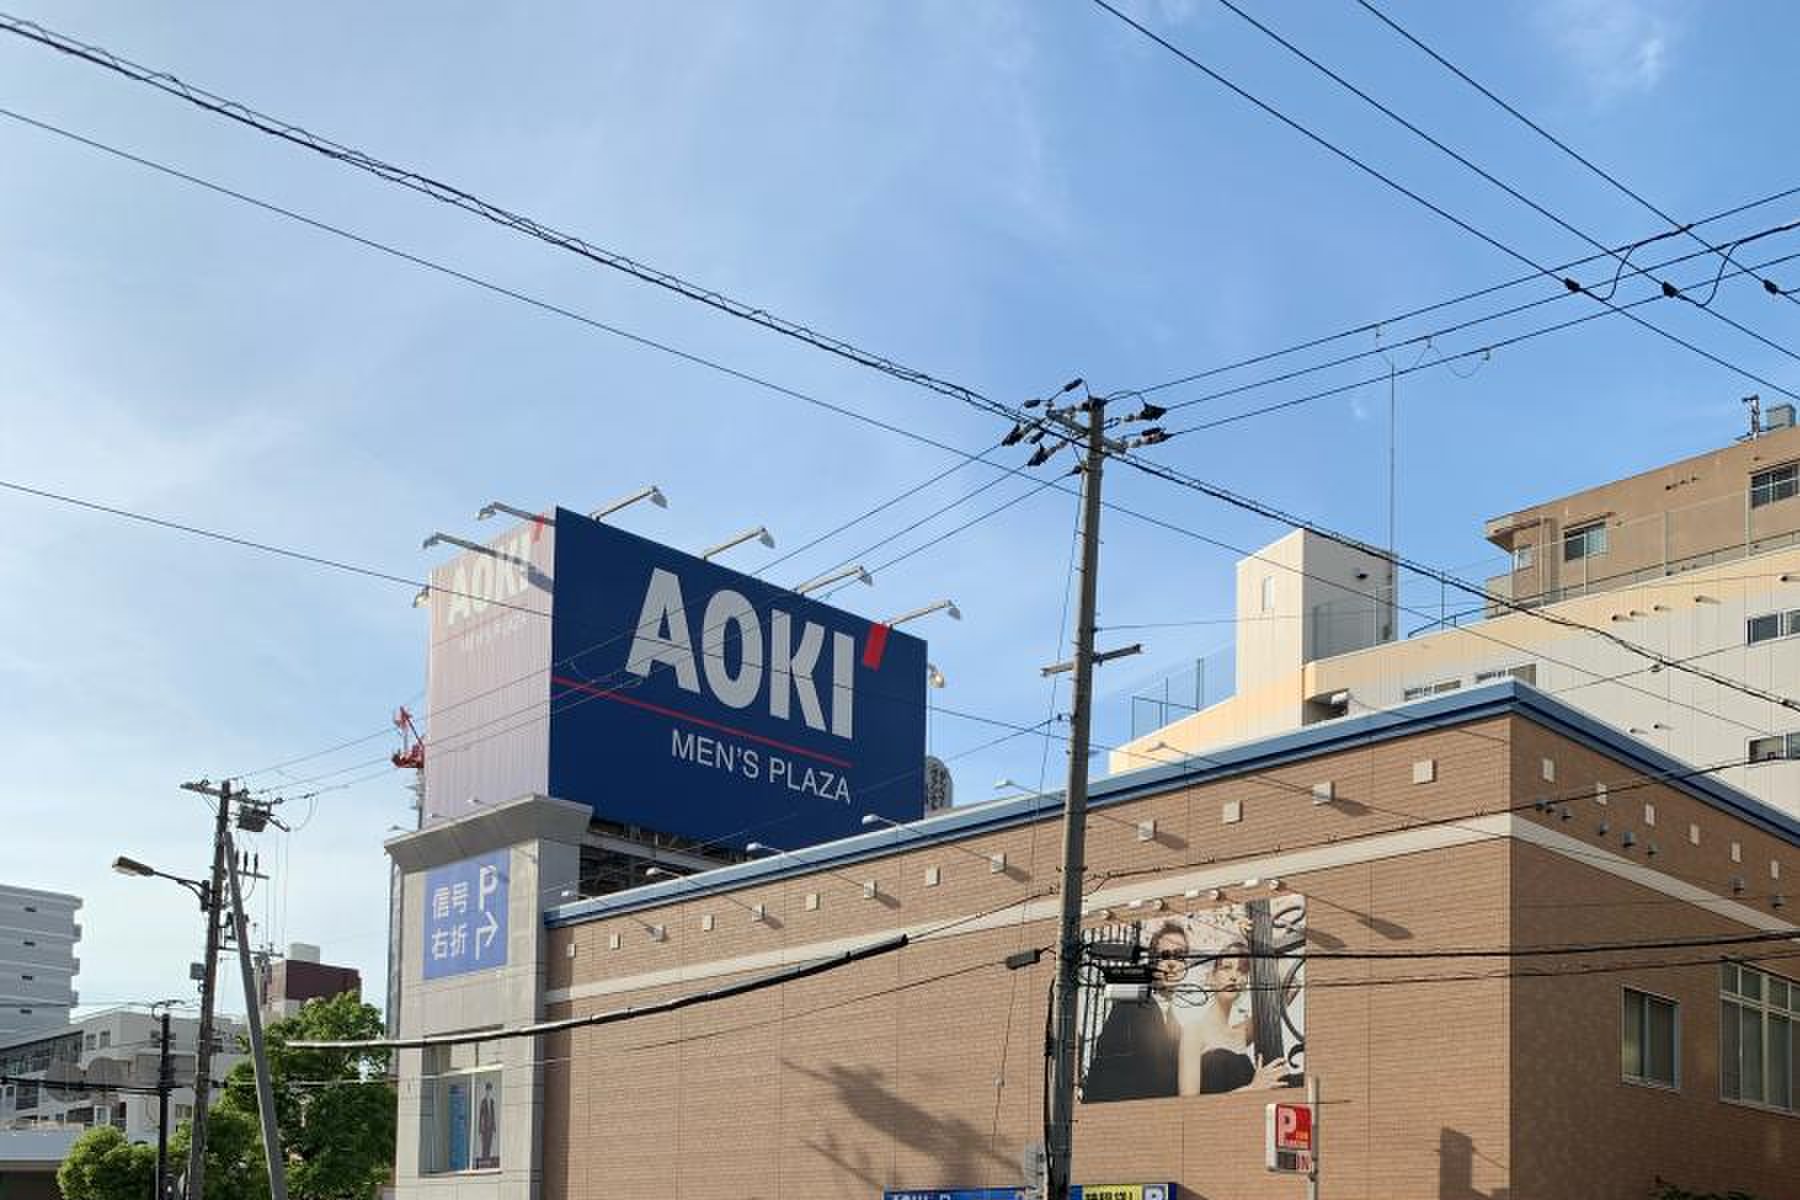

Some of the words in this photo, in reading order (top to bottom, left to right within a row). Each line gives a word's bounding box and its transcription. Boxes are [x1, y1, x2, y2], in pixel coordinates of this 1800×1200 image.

[625, 566, 855, 740] AOKI
[671, 728, 759, 780] MEN'S
[769, 757, 851, 805] PLAZA
[432, 881, 469, 920] 信号
[479, 864, 498, 912] P
[431, 923, 467, 961] 右折
[1278, 1106, 1297, 1140] P
